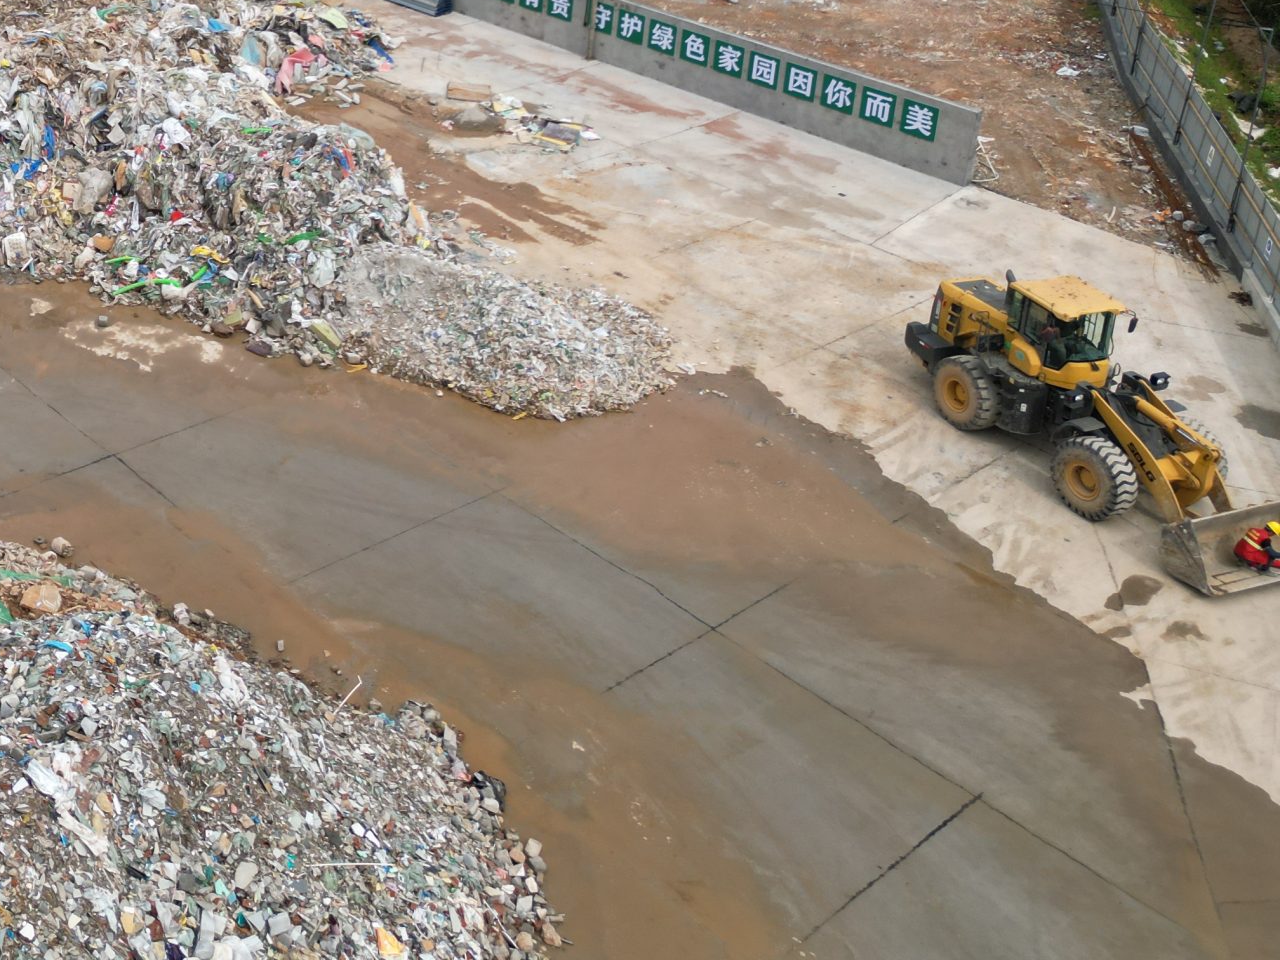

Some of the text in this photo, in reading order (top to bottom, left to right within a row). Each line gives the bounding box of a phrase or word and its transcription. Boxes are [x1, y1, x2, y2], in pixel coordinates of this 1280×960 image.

[595, 4, 933, 137] 守护绿色家园因你而美
[1128, 443, 1156, 482] SDLG
